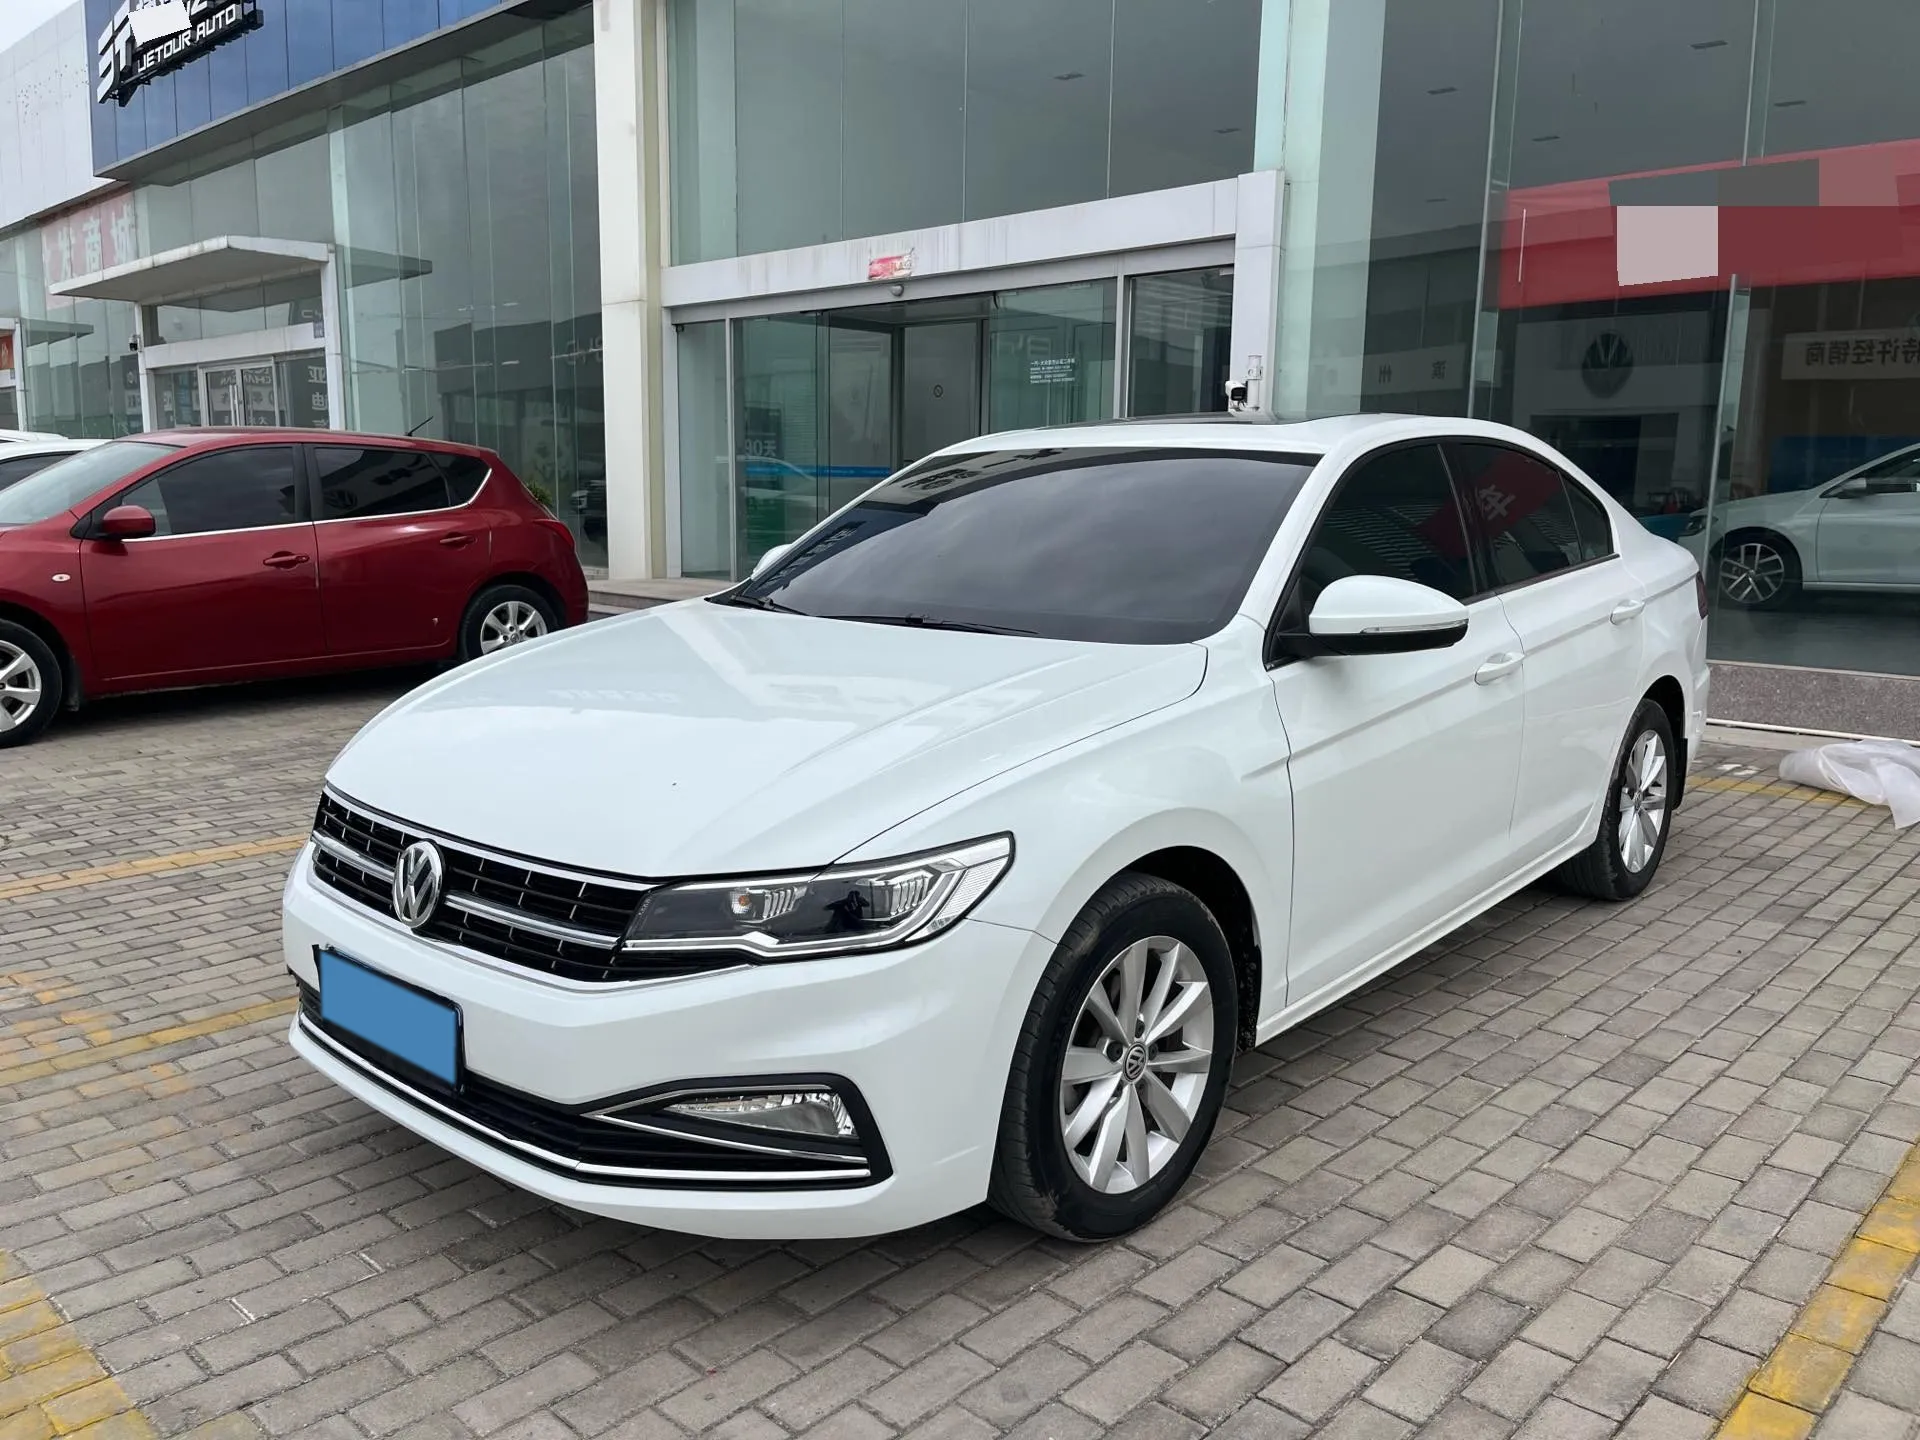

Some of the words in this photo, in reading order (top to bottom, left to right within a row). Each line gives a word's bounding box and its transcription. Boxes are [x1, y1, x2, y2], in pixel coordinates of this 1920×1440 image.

[137, 29, 192, 72] JETOUR
[196, 4, 237, 43] AUTO
[745, 440, 777, 457] 90天
